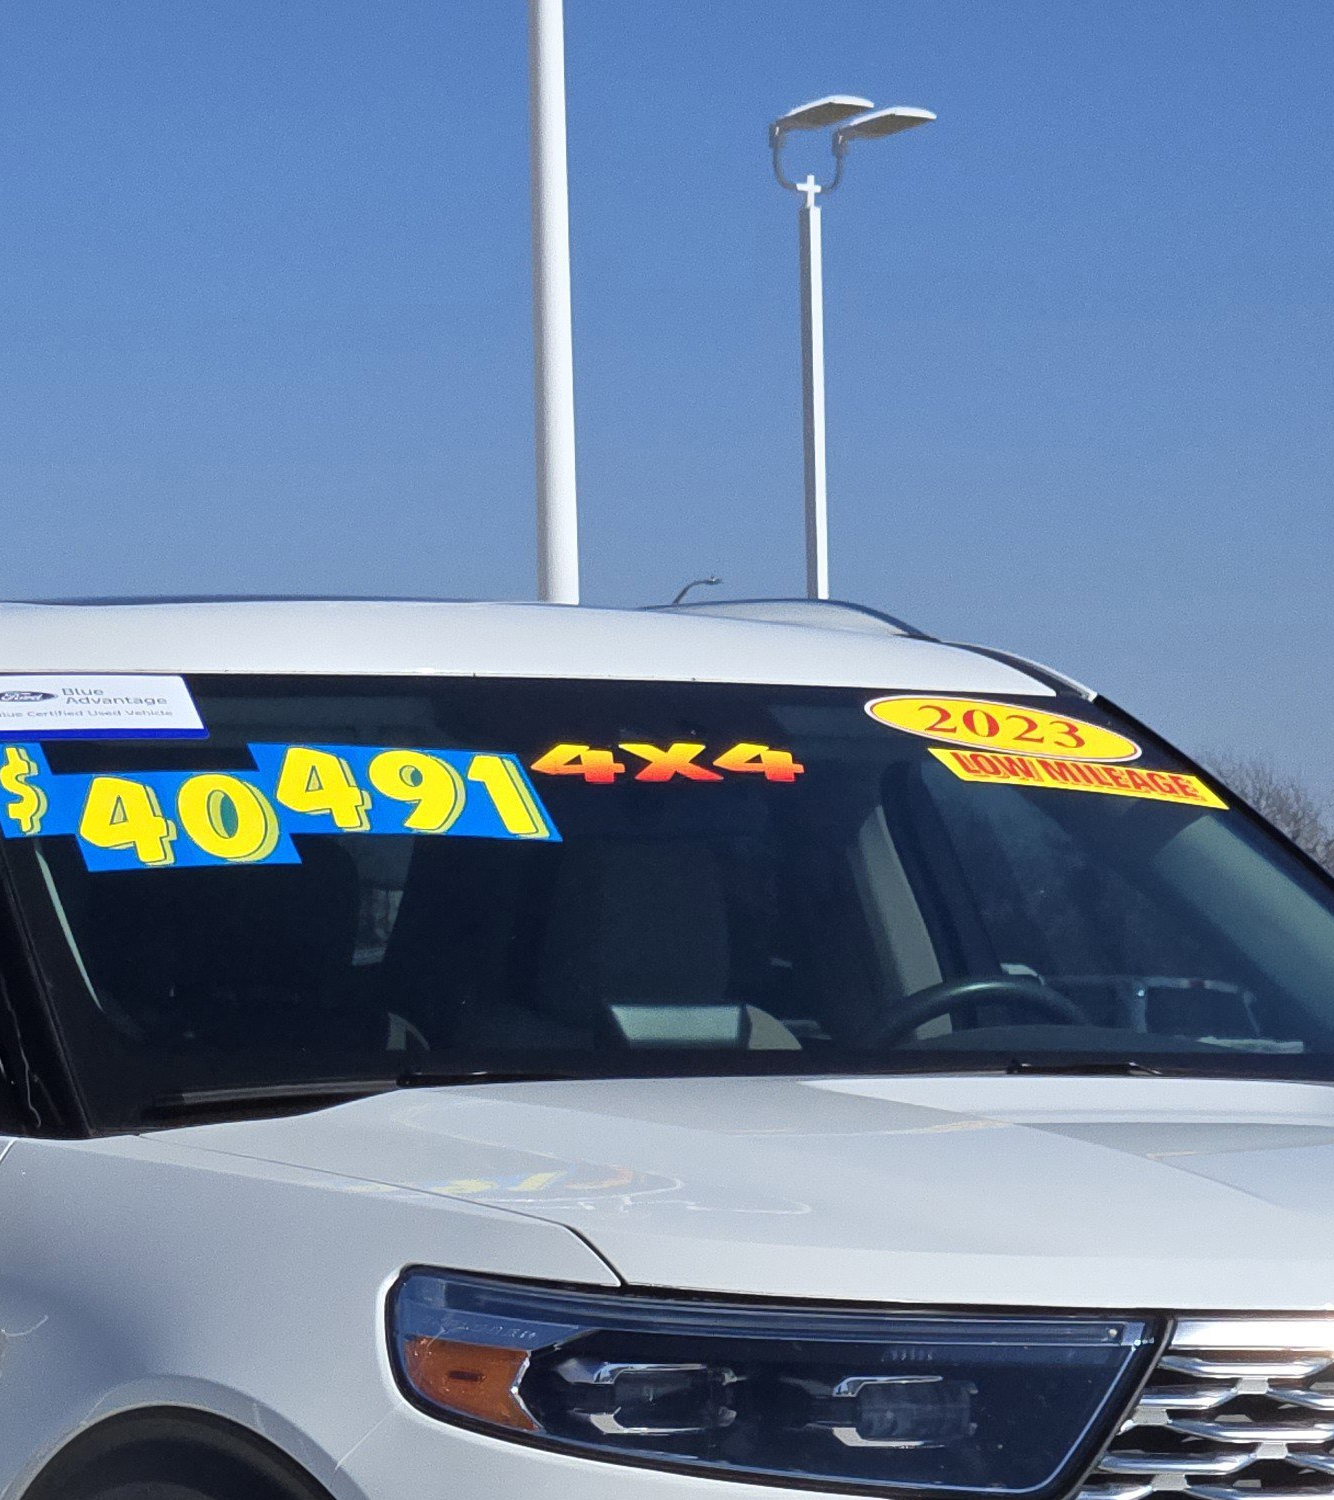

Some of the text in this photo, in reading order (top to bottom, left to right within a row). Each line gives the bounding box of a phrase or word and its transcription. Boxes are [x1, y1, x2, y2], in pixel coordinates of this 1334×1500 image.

[62, 688, 104, 696] Blue
[66, 696, 168, 706] Advantage
[918, 705, 1086, 748] 2023
[950, 751, 1205, 800] LOW MILEAGE
